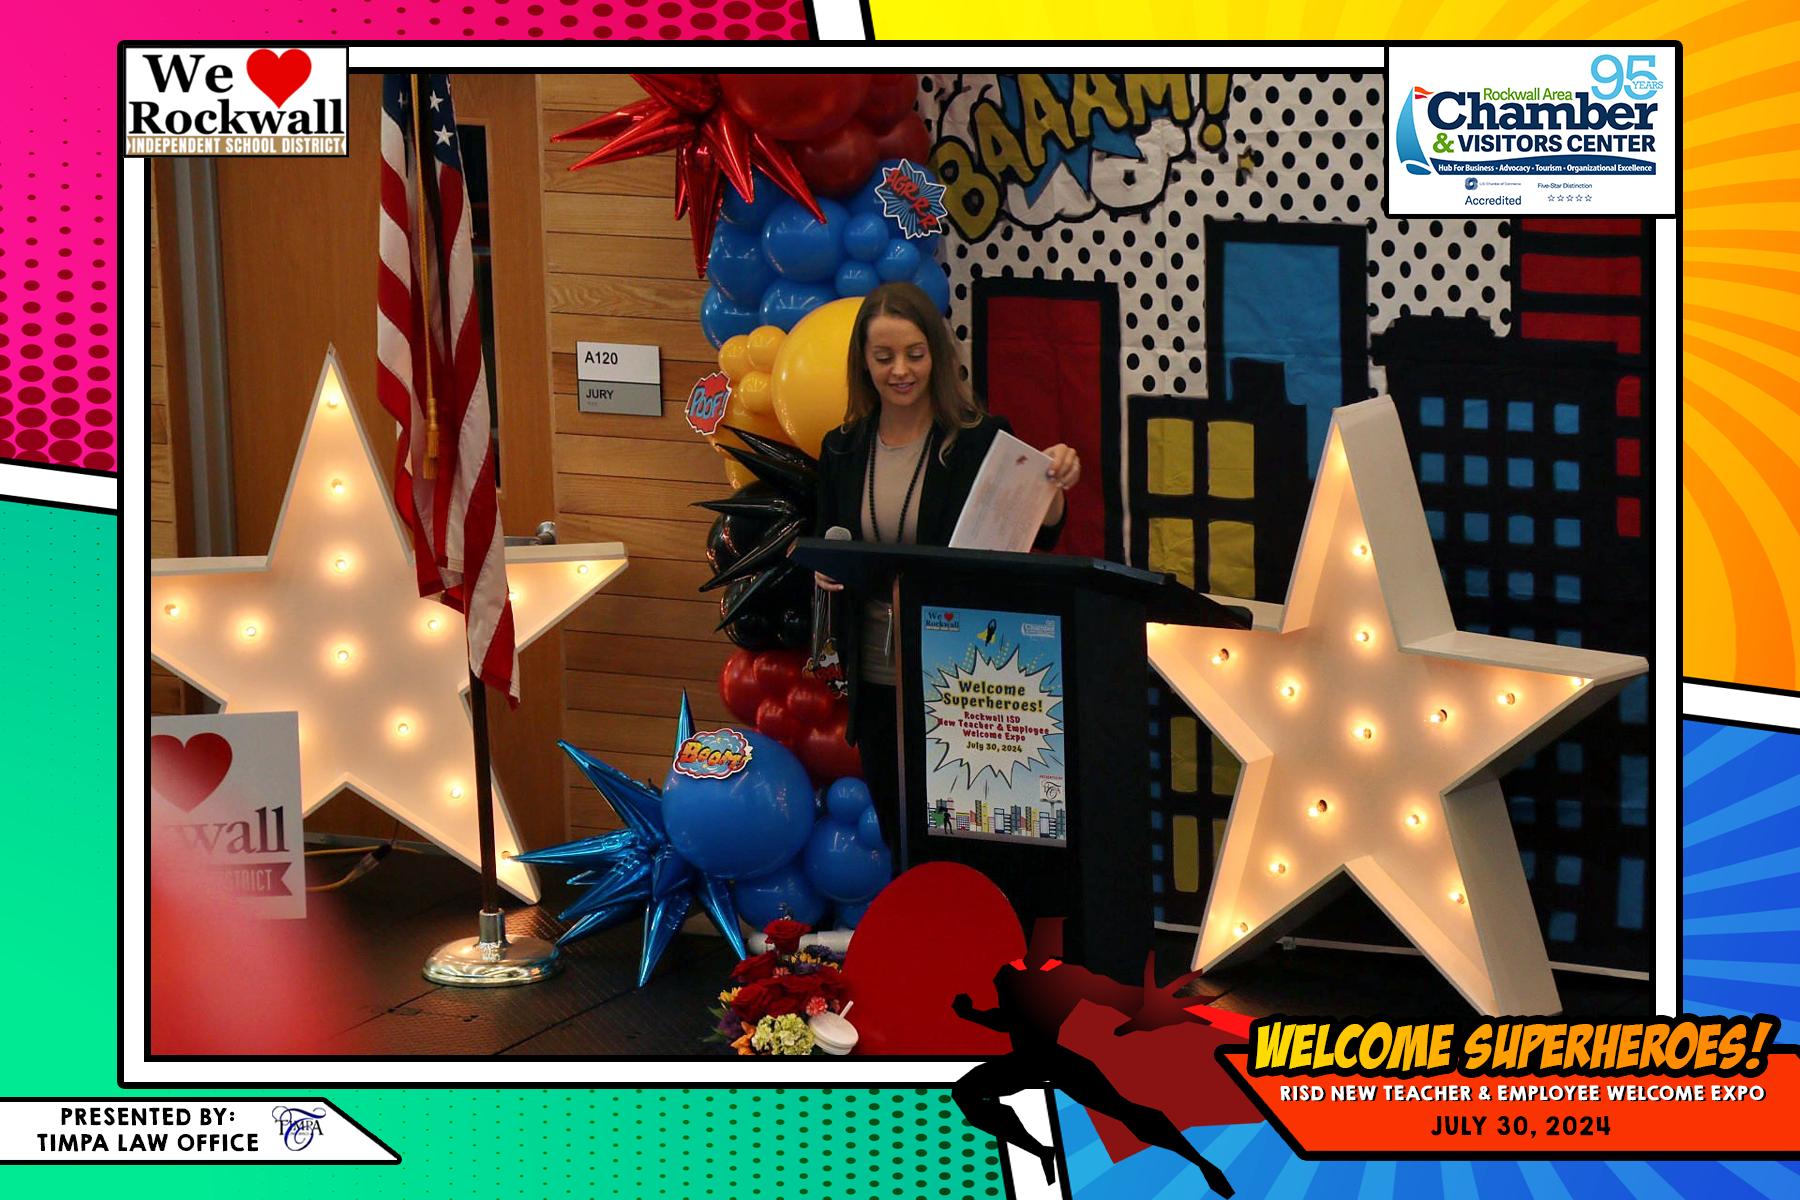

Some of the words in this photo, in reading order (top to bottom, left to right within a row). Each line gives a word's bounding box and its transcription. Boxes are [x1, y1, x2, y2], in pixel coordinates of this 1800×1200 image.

[584, 351, 618, 365] A120
[586, 389, 614, 400] JURY
[958, 680, 1025, 696] Welcome
[943, 692, 1043, 712] Superheroes!
[964, 711, 1004, 722] Rockwall
[1006, 715, 1021, 723] ISD
[937, 718, 956, 727] New
[958, 719, 994, 730] Teacher
[996, 723, 1004, 731] &
[1006, 725, 1050, 736] Employee
[962, 729, 1002, 739] Welcome
[1005, 732, 1026, 742] Expo
[966, 741, 984, 751] July
[986, 742, 1000, 752] 30,
[1001, 744, 1022, 752] 2024
[165, 806, 290, 854] wall
